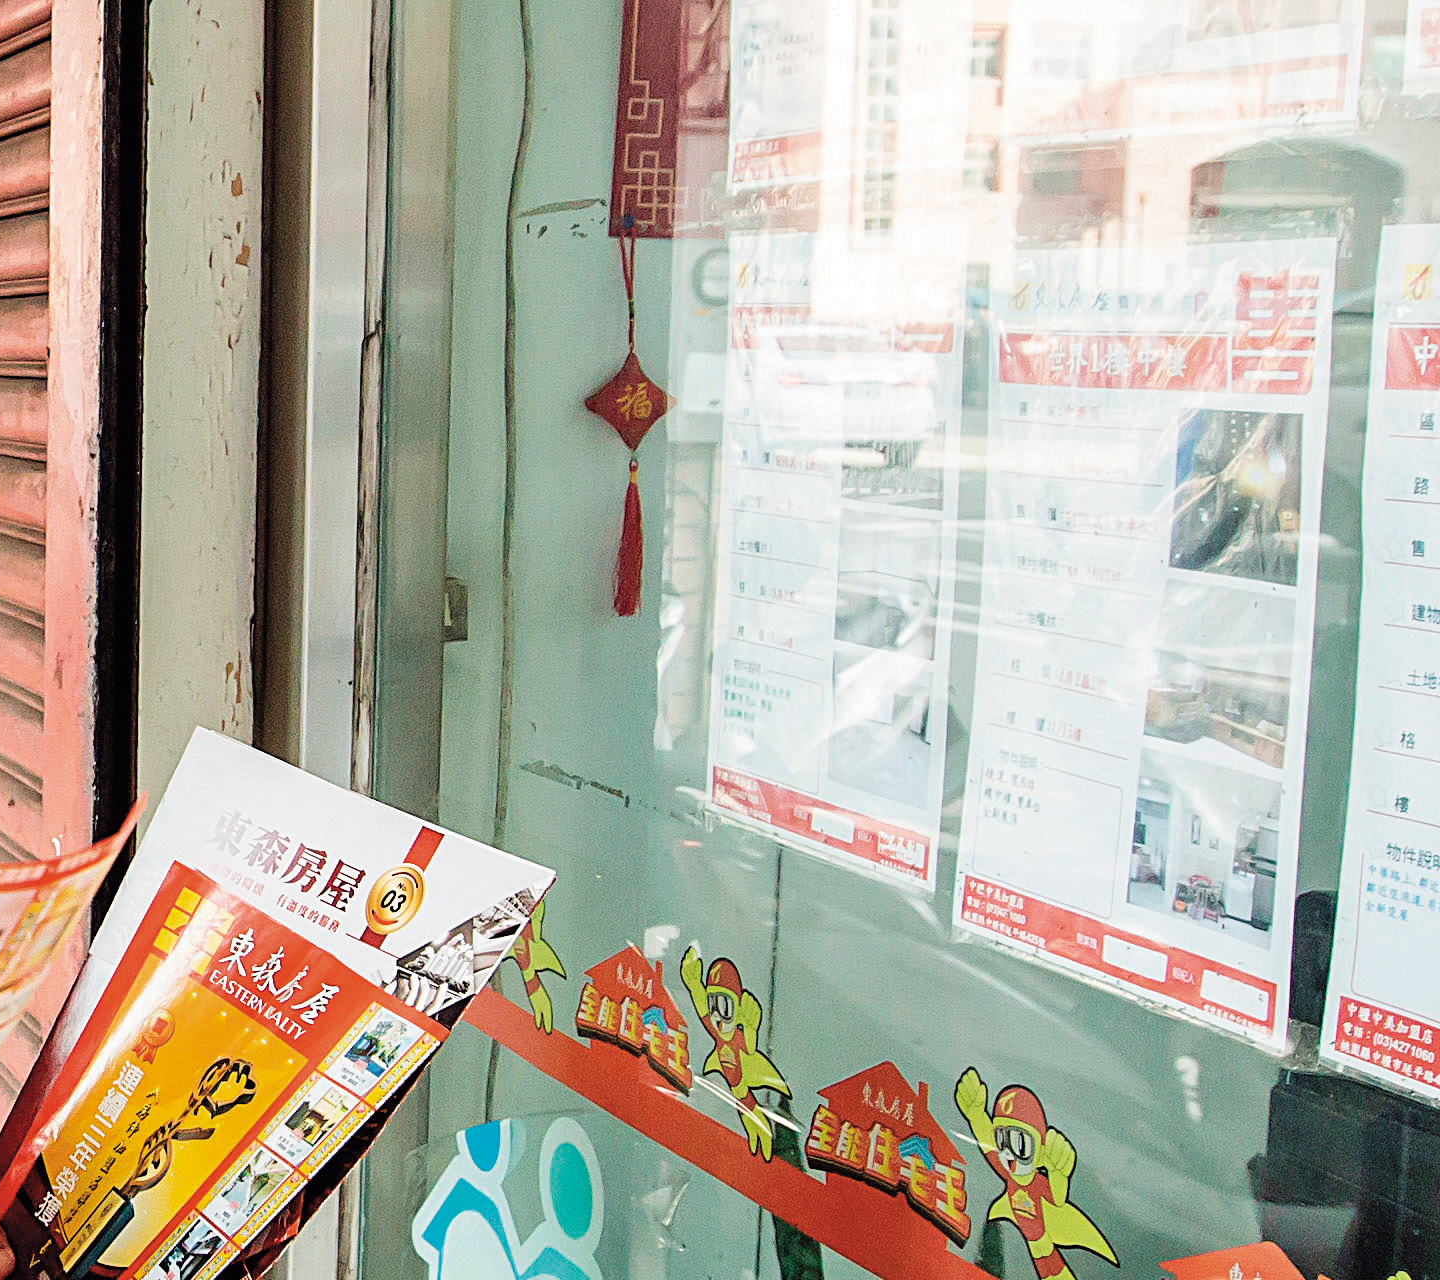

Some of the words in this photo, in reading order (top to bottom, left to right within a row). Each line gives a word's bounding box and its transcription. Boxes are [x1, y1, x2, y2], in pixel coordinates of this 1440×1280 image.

[616, 381, 652, 421] 福
[204, 808, 366, 912] 東森房屋
[381, 890, 407, 914] 03
[209, 970, 265, 1021] EASTERN
[219, 928, 341, 1025] 東森房屋
